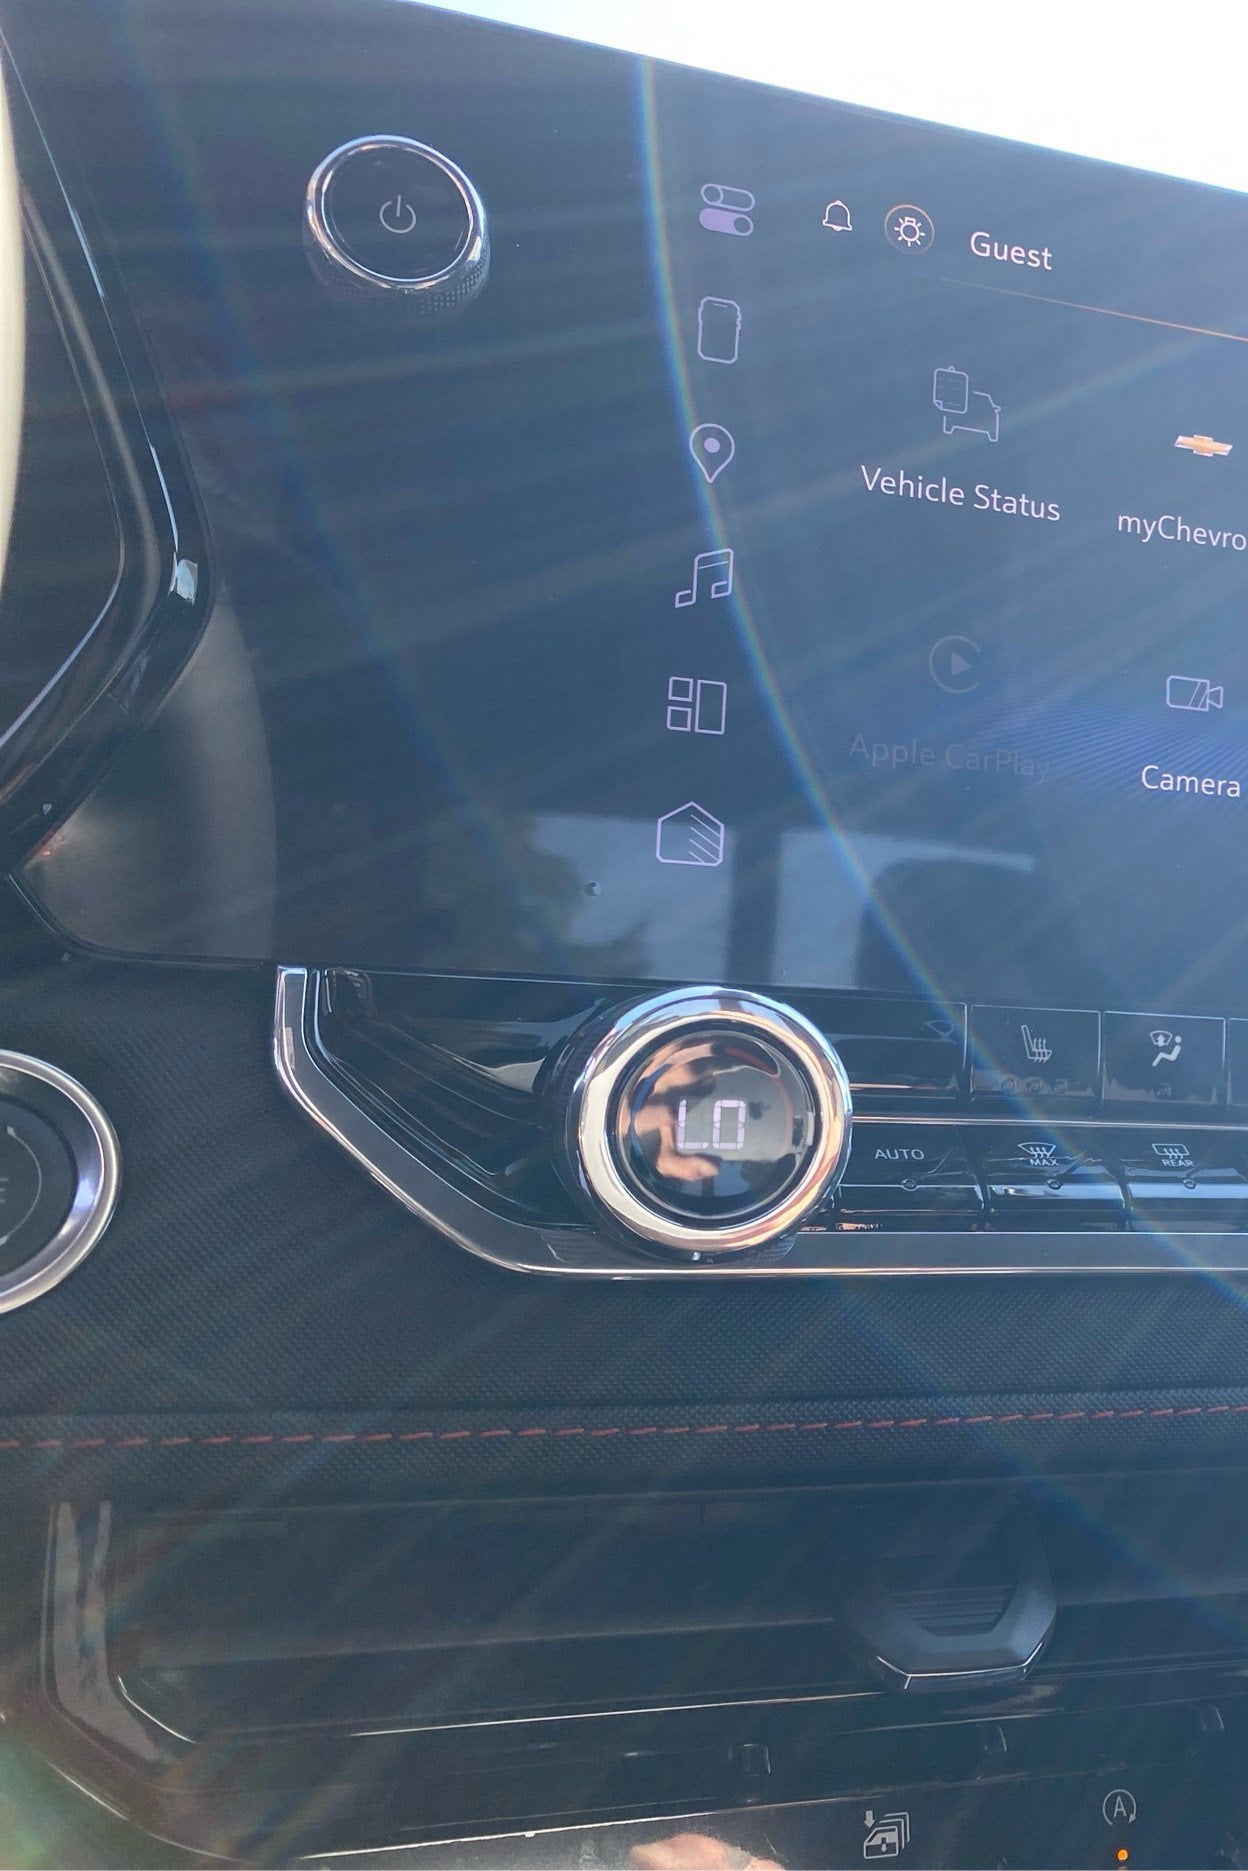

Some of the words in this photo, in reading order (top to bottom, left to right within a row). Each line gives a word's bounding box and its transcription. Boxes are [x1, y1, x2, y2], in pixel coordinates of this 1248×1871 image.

[969, 231, 1053, 271] Guest
[860, 463, 966, 507] Vehicle
[973, 483, 1061, 522] Status
[849, 732, 936, 771] Apple
[946, 743, 1051, 785] CarPlay
[1140, 764, 1242, 799] Camera
[676, 1098, 746, 1151] LO
[873, 1147, 926, 1161] AUTO
[1028, 1157, 1060, 1168] MAX
[1161, 1158, 1195, 1168] REAR
